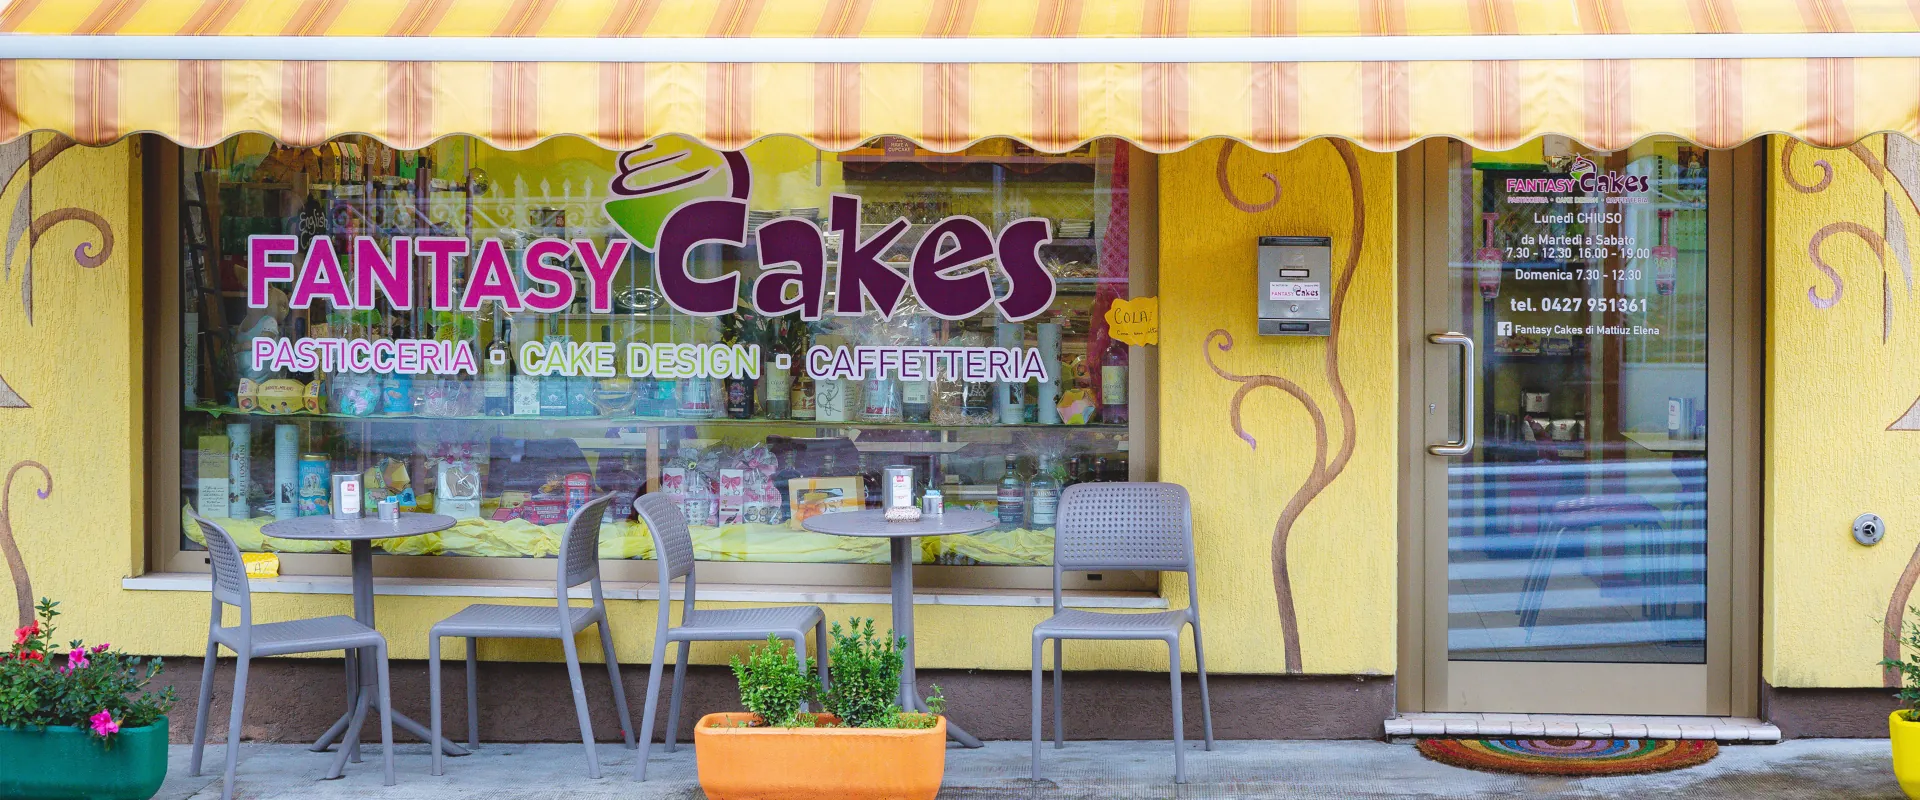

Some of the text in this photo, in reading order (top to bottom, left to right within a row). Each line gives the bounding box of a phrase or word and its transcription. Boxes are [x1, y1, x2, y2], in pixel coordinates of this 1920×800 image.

[1506, 172, 1649, 194] FANTASY Cakes
[299, 209, 330, 235] English
[1534, 212, 1622, 224] Lunedì CHIUSO
[1522, 234, 1635, 246] da Martedì a Sabato
[248, 194, 1057, 323] FANTASY Cakes
[1507, 248, 1530, 258] 7.30
[1542, 248, 1572, 258] 12.30
[1579, 248, 1608, 258] 16.00
[1621, 248, 1650, 258] 19.00
[1516, 269, 1572, 280] Domenica
[1576, 270, 1600, 280] 7.30
[1612, 270, 1642, 280] 12.30
[1510, 298, 1648, 312] tel. 0427 951361
[1515, 325, 1551, 336] Fantasy
[1554, 326, 1582, 335] Cakes
[1586, 326, 1594, 335] di
[1597, 326, 1630, 335] Mattiuz
[1634, 326, 1660, 335] Elena
[252, 337, 1049, 382] PASTICCERIA CAKE DESIGN CAFFETTERIA
